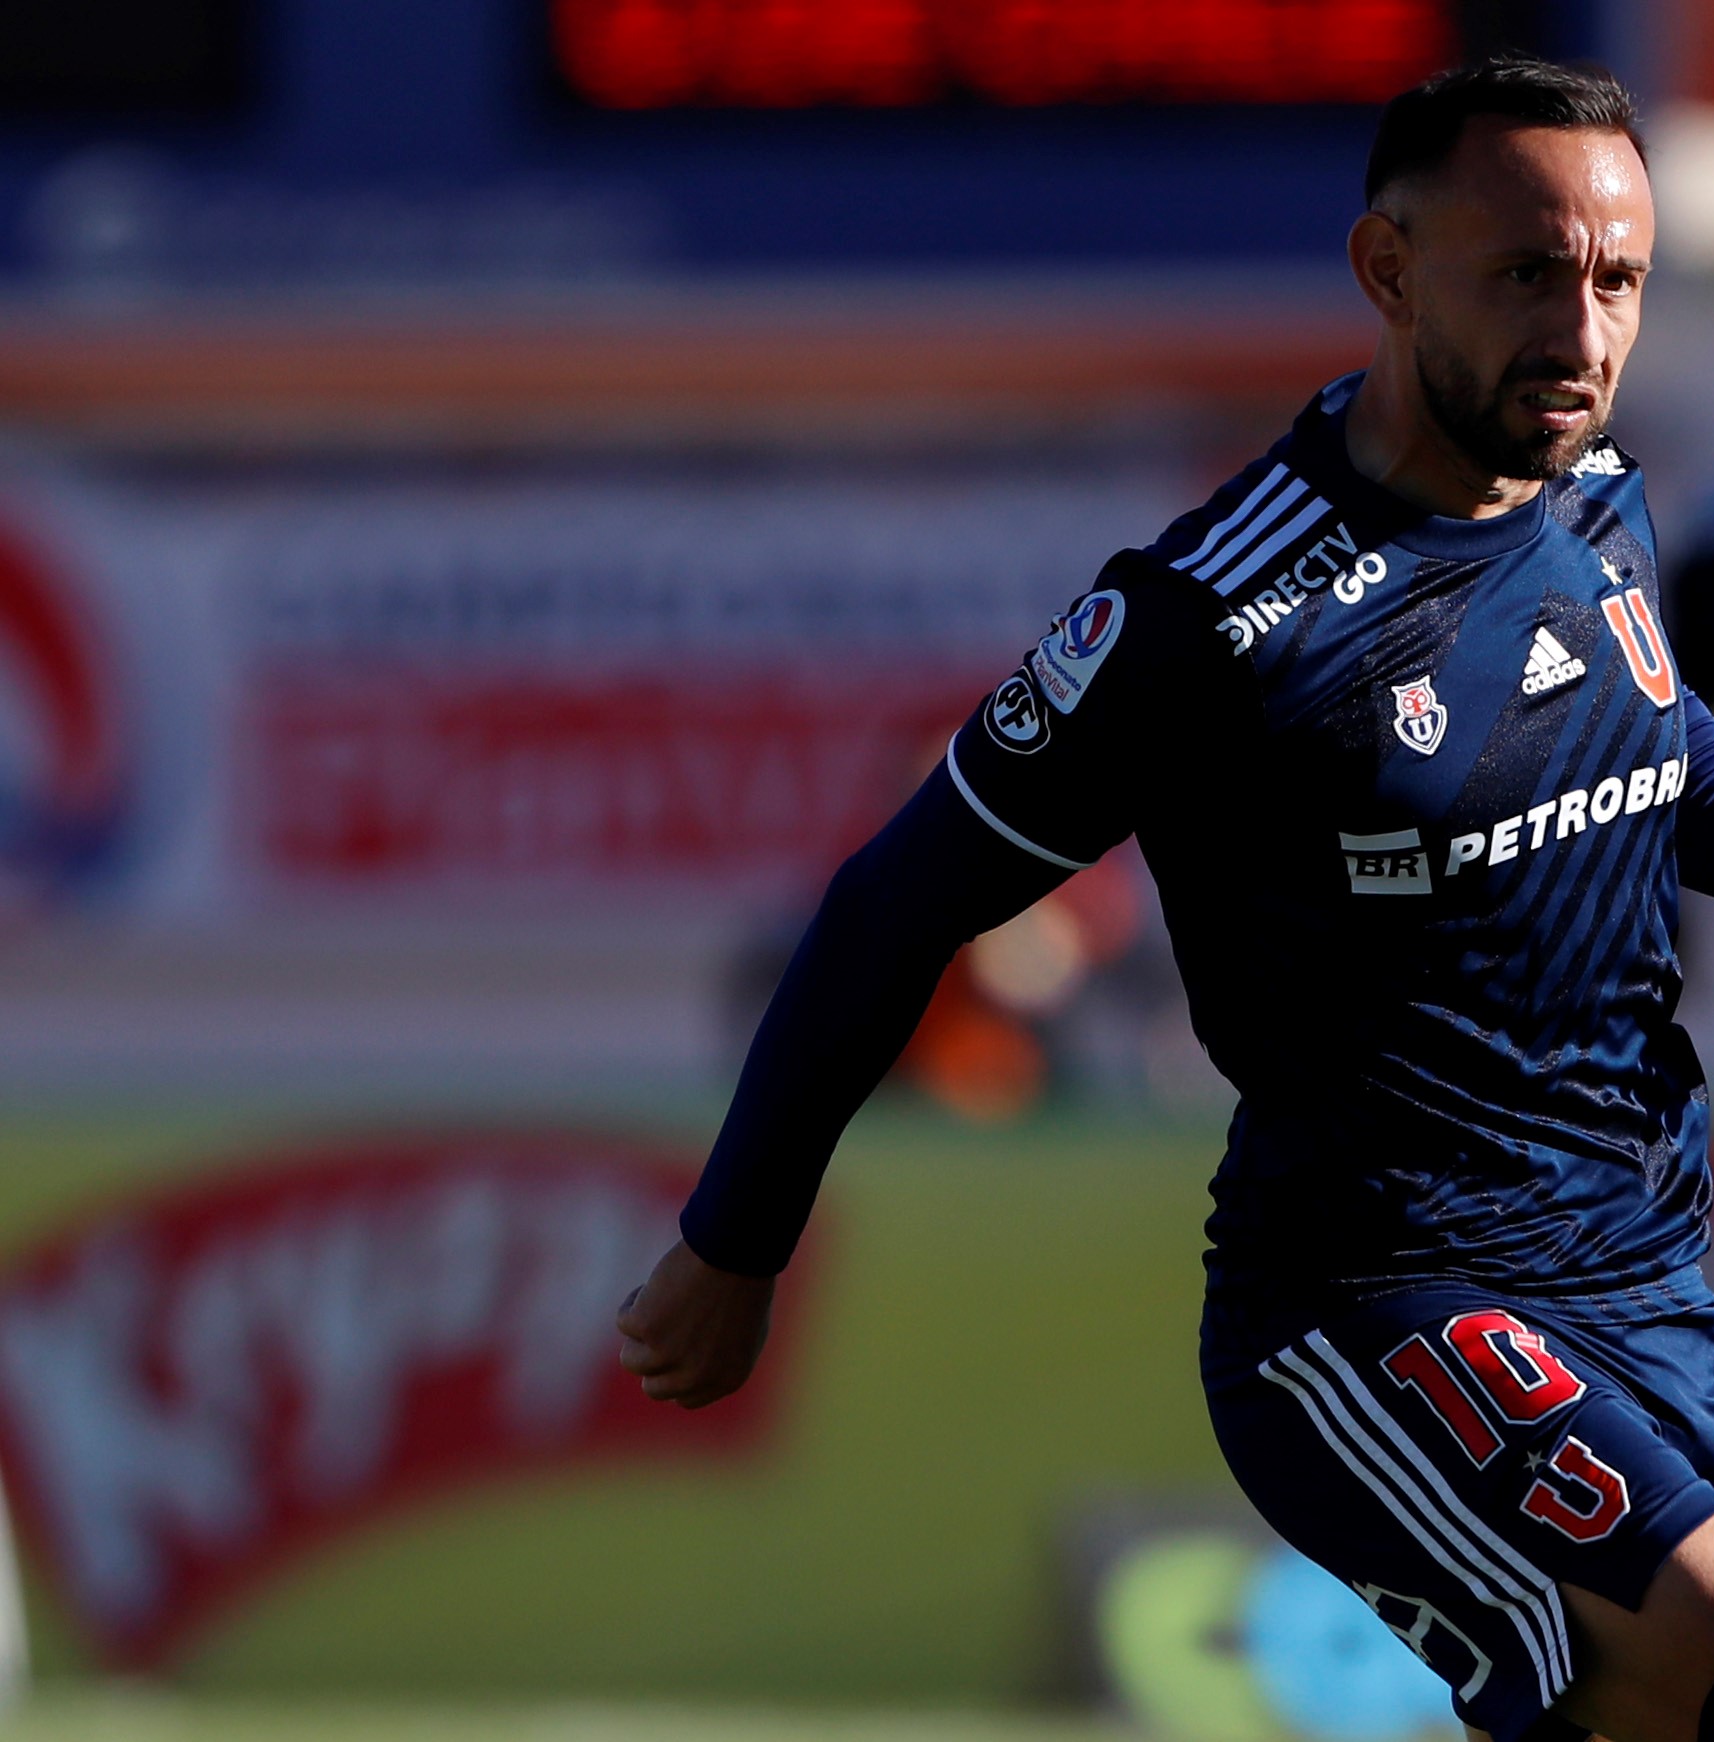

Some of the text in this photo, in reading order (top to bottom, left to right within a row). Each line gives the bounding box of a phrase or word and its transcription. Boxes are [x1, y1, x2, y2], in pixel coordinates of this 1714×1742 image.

[1333, 552, 1387, 604] GO
[1601, 587, 1678, 709] U
[1521, 658, 1586, 695] adidas
[1408, 713, 1434, 742] U
[1355, 853, 1419, 878] BR
[1380, 1308, 1588, 1471] 10
[1519, 1435, 1631, 1543] U
